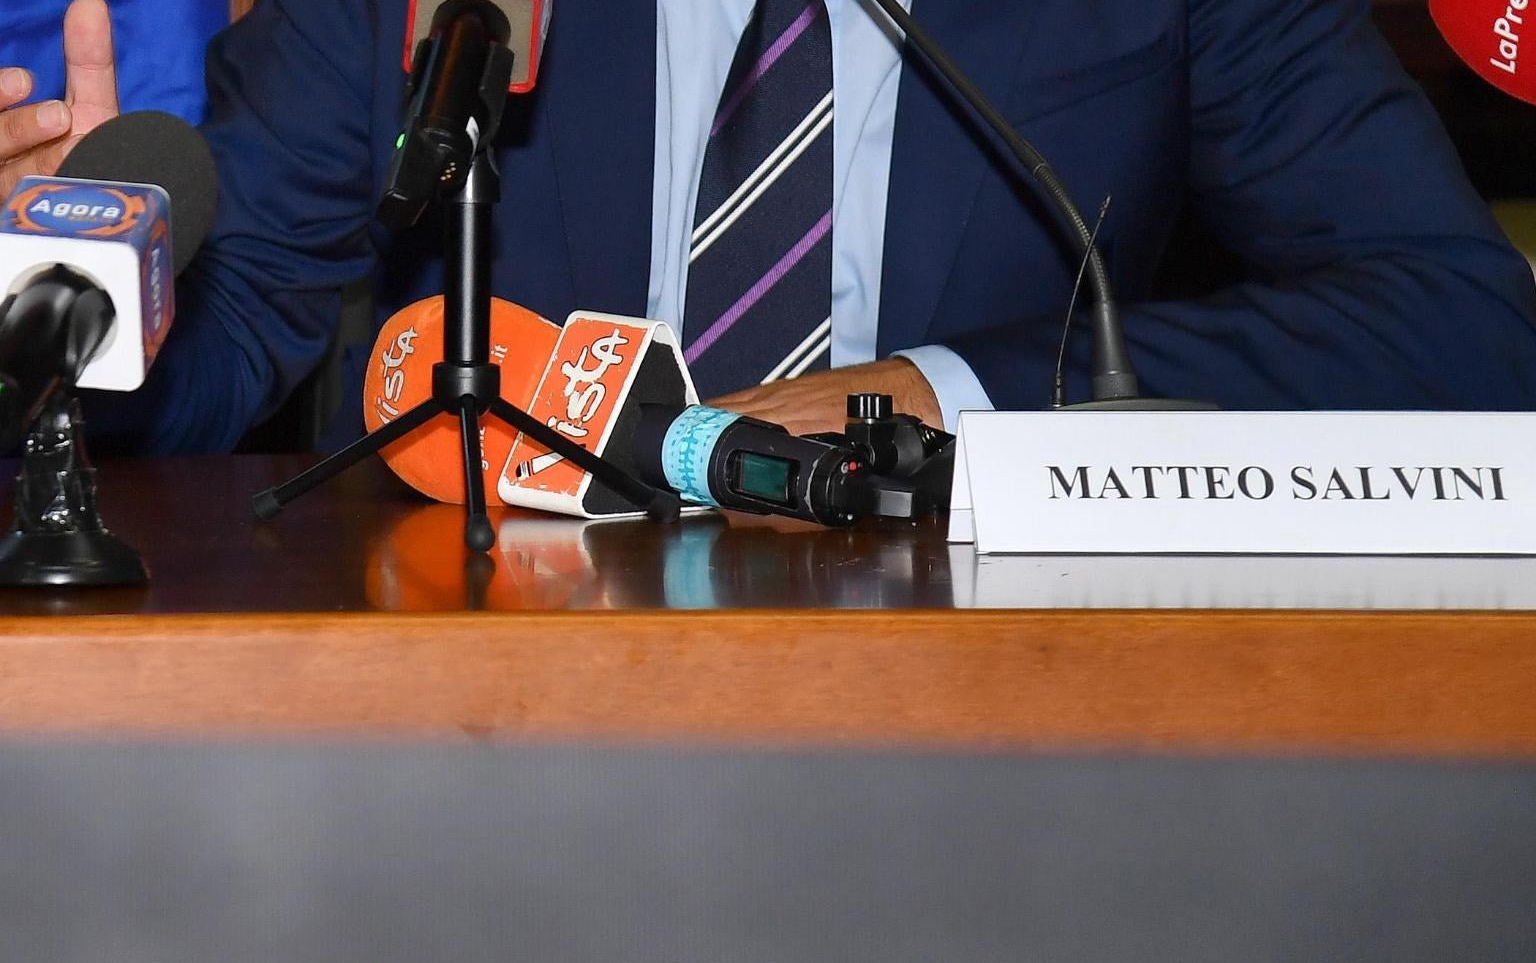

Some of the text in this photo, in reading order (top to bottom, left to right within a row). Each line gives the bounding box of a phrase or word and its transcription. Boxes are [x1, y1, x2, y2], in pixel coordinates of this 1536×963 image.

[30, 198, 121, 219] Agora
[1045, 464, 1508, 501] MATTEO SALVINI
